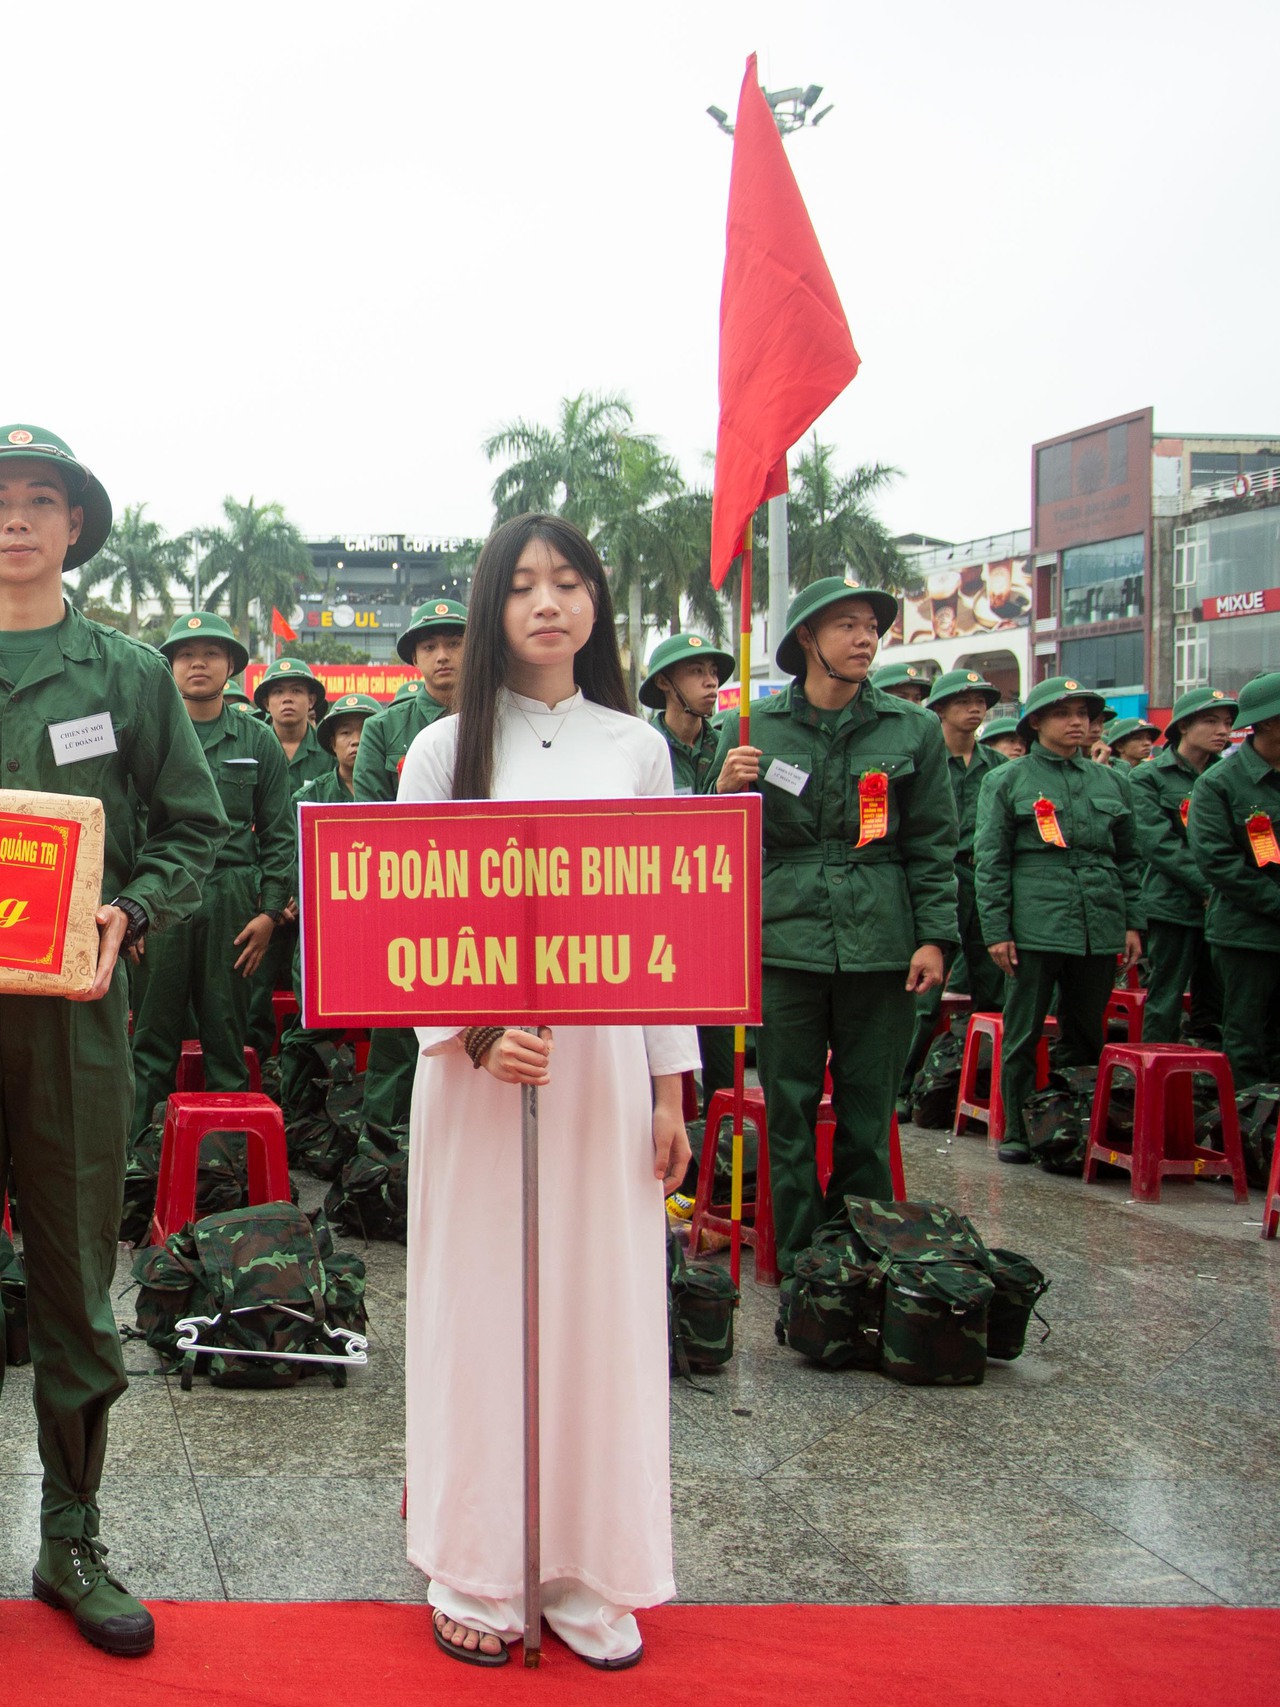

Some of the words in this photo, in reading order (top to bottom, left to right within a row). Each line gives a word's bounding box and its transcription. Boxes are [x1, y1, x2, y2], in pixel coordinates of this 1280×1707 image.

[344, 535, 398, 552] CAMON
[403, 535, 458, 553] COFFEE
[1216, 590, 1264, 613] MIXUE
[0, 832, 38, 863] QUẢNG
[40, 842, 59, 870] TRỊ
[330, 841, 372, 900] LỮ
[379, 839, 469, 900] ĐOÀN
[480, 837, 570, 897] CÔNG
[581, 845, 661, 896] BINH
[672, 844, 733, 894] 414
[387, 926, 518, 992] QUÂN
[535, 934, 630, 985] KHU
[647, 934, 676, 982] 4
